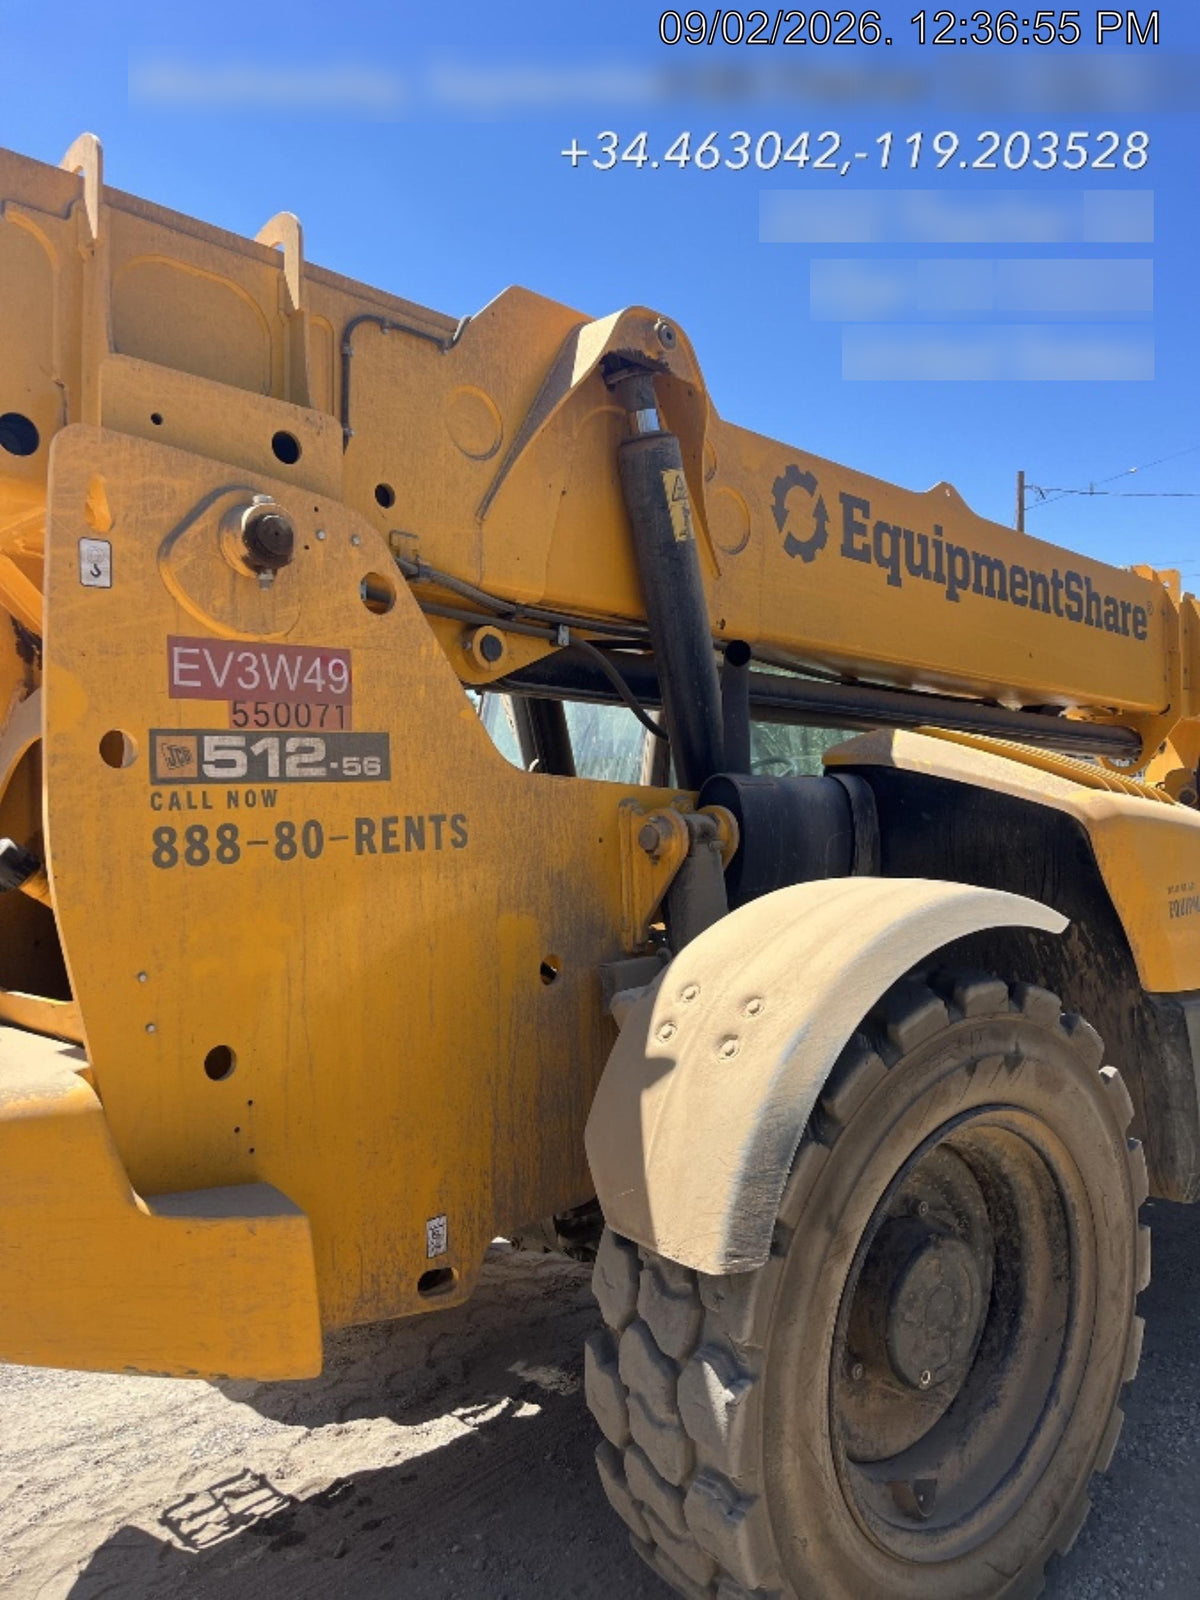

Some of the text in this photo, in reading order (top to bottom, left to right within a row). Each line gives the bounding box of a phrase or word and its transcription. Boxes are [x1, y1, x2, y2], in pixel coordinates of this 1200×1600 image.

[173, 647, 349, 694] EV3W49
[232, 702, 345, 729] 550071
[150, 789, 278, 811] CALL NOW
